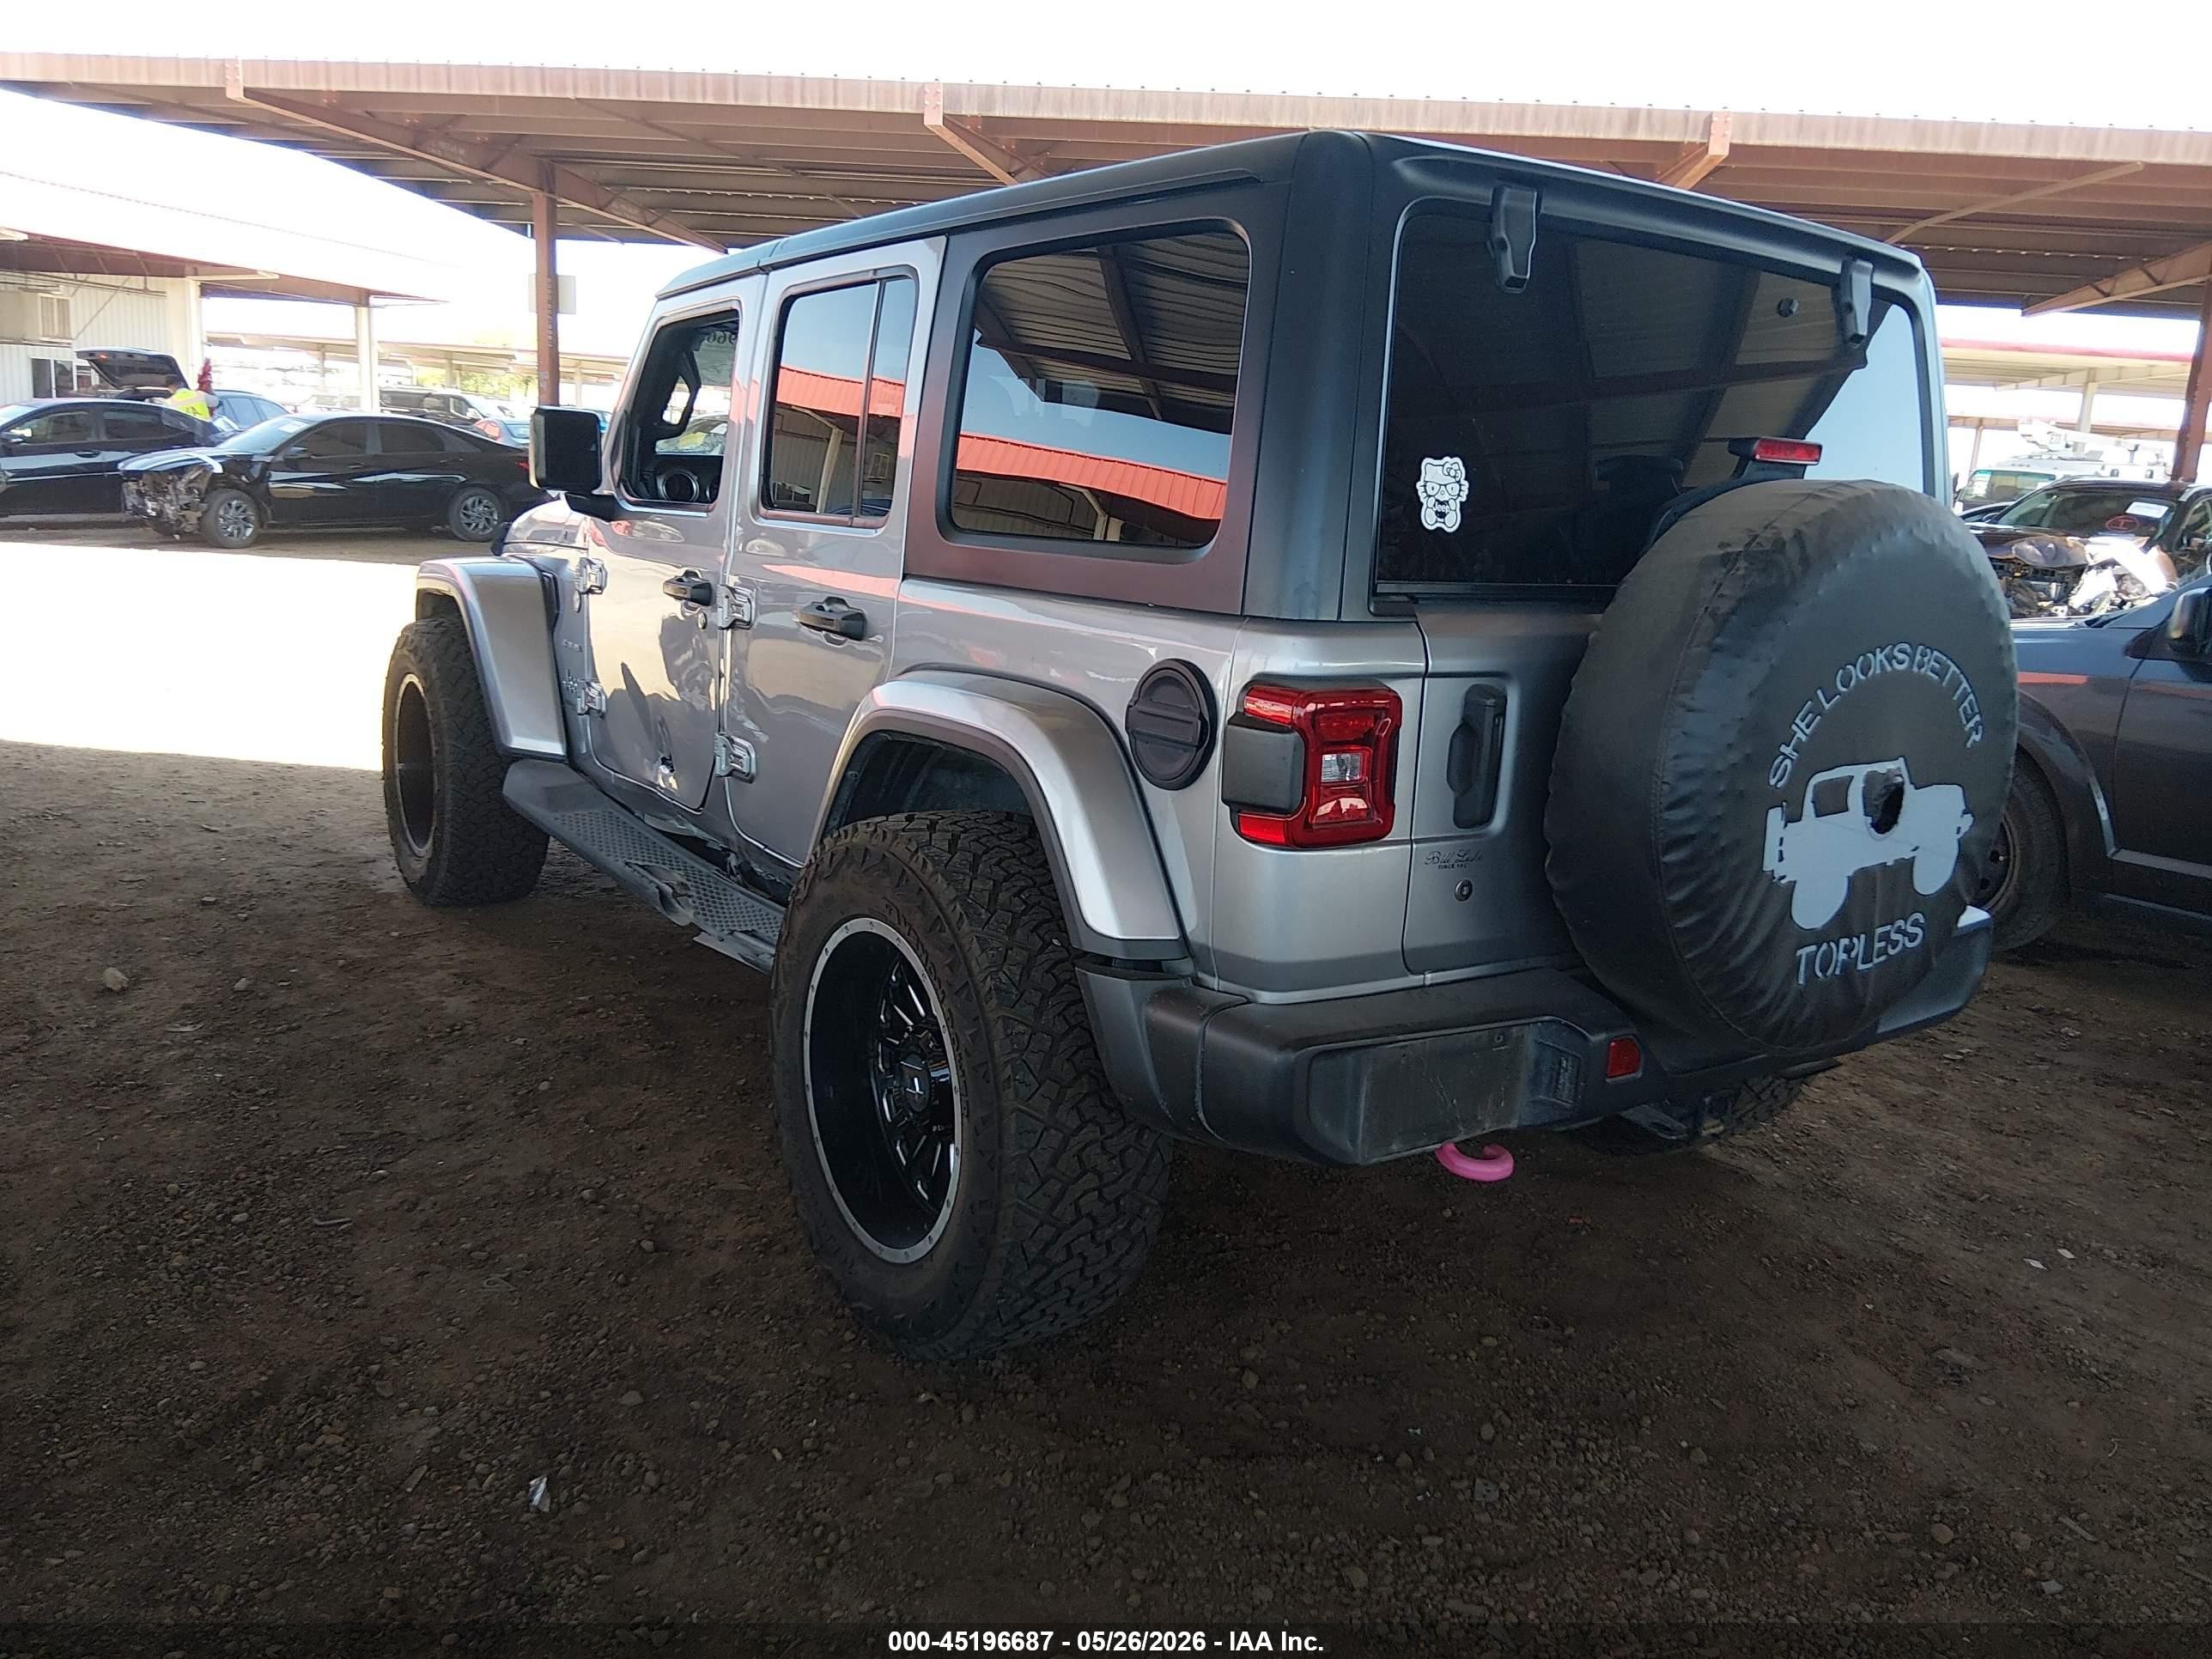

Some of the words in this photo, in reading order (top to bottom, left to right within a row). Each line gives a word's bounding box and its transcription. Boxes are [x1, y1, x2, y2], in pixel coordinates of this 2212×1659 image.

[1434, 501, 1450, 514] Jeep
[1768, 700, 1821, 789] SHE
[1816, 642, 1912, 711] LOOKS
[1911, 644, 1984, 749] BETTER
[1424, 850, 1455, 866] Bill
[1796, 912, 1925, 985] TOPLESS
